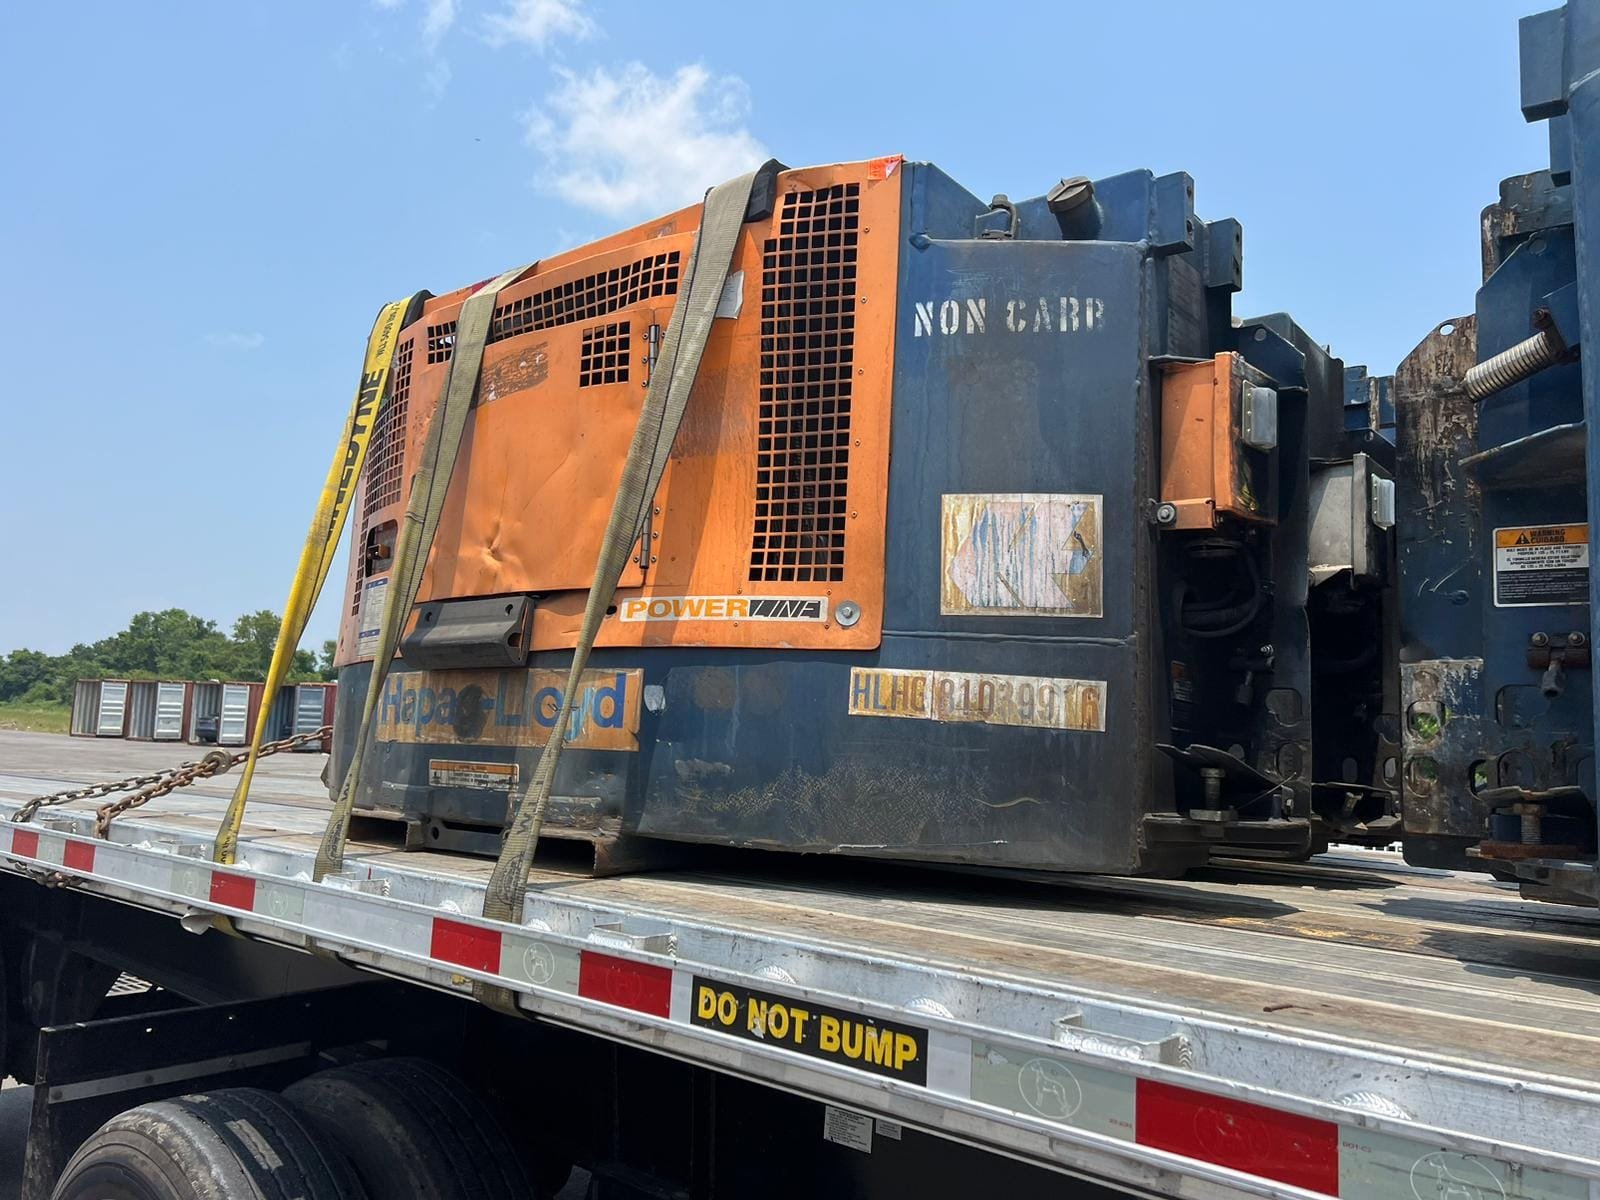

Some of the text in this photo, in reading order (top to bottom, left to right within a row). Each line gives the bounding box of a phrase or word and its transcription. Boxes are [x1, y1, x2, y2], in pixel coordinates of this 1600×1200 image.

[914, 298, 986, 337] NON
[380, 673, 627, 740] Hapa-Lloyd
[698, 986, 918, 1071] DO NOT BUMP
